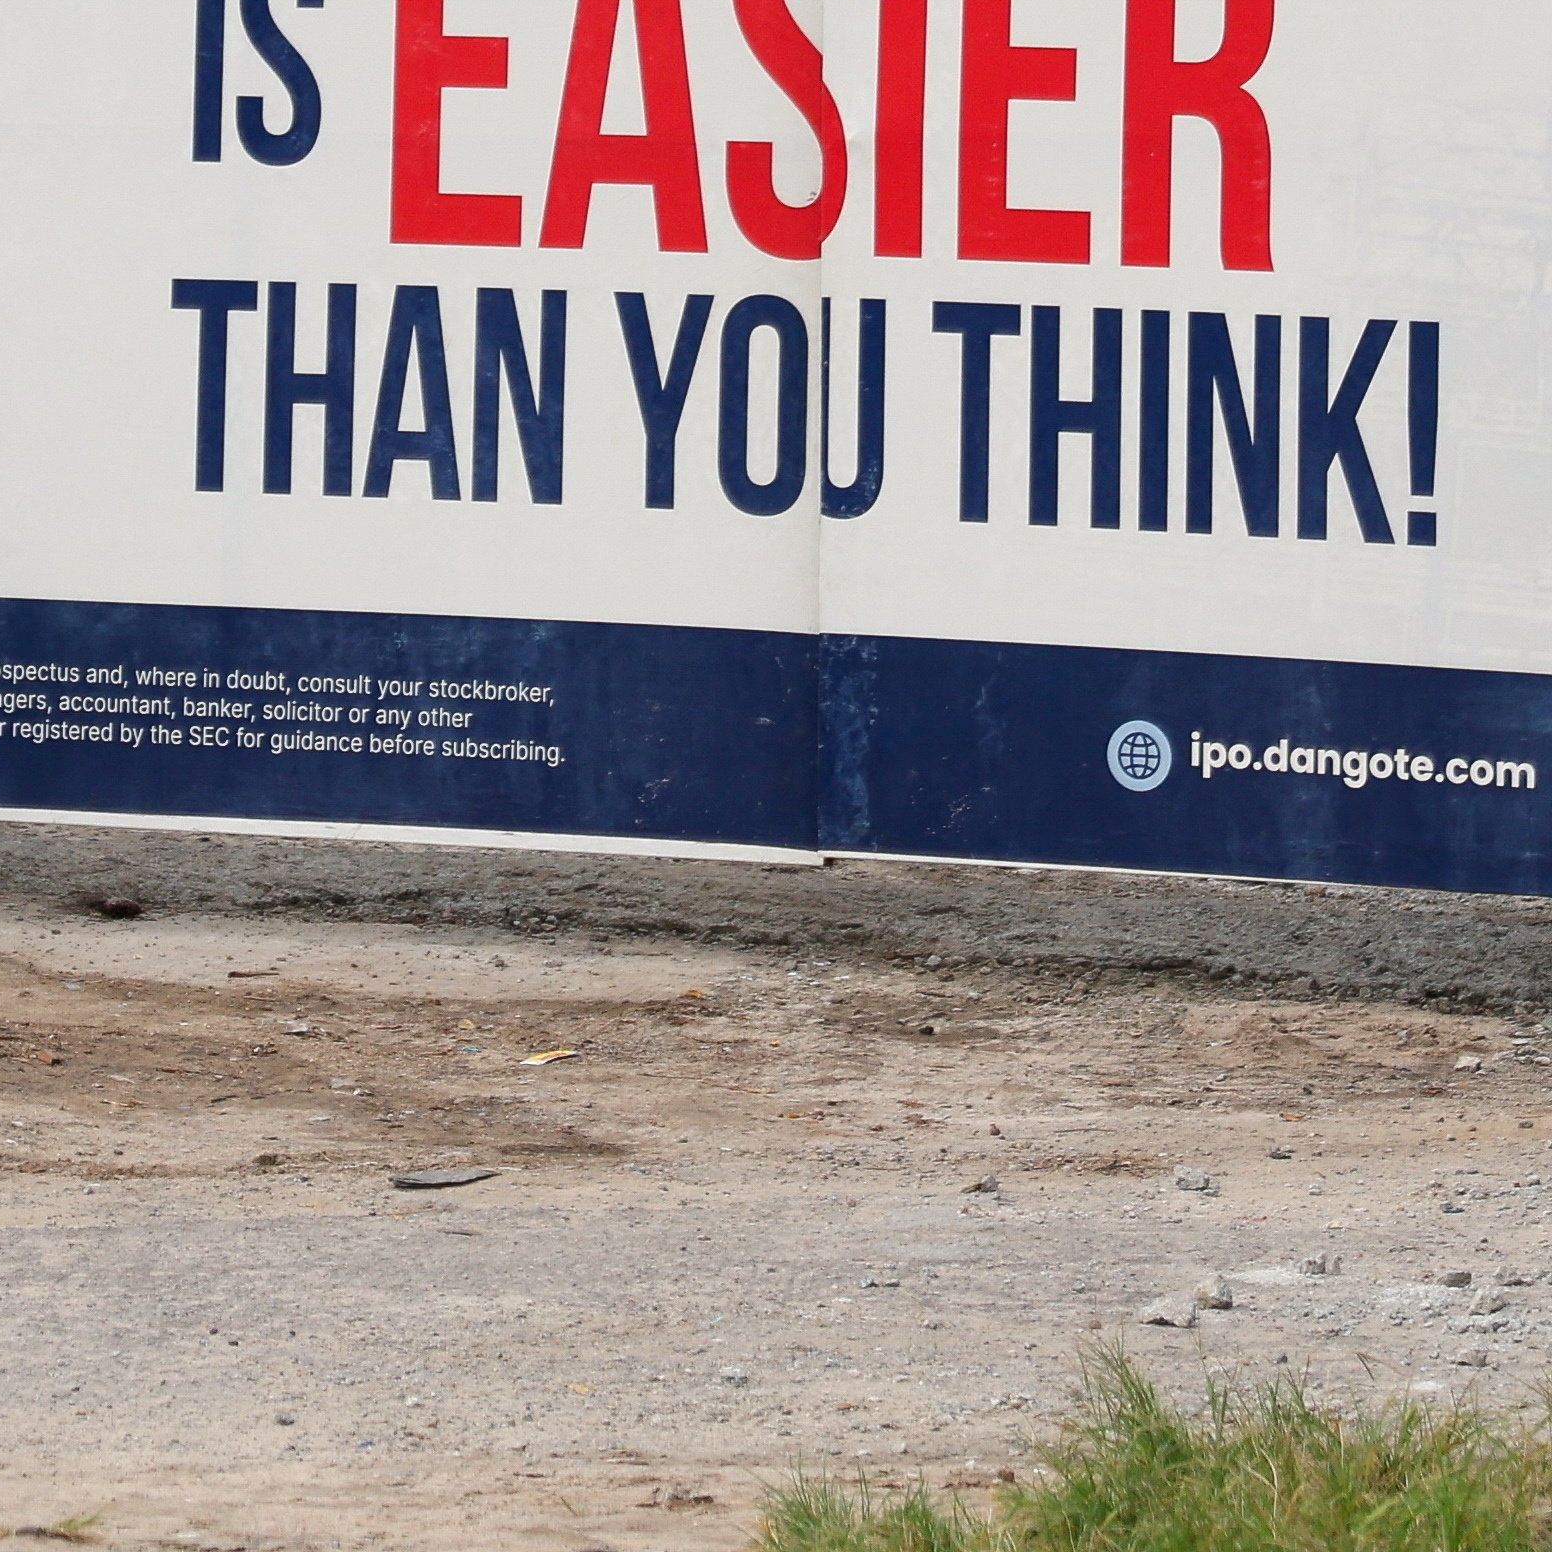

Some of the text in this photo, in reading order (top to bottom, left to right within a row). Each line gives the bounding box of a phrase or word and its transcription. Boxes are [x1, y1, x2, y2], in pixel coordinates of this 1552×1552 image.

[171, 278, 1440, 547] THAN YOU THINK!
[85, 664, 129, 689] and,
[135, 666, 197, 688] where
[202, 667, 220, 689] in
[226, 669, 292, 696] doubt,
[297, 674, 372, 695] consult
[377, 679, 423, 700] your
[428, 679, 555, 708] stockbroker,
[58, 694, 176, 720] accountant,
[182, 696, 256, 723] banker,
[262, 700, 343, 723] solicitor
[348, 706, 369, 724] or
[375, 707, 412, 730] any
[417, 707, 473, 729] other
[12, 718, 113, 744] registered
[119, 722, 144, 749] by
[149, 724, 183, 746] the
[188, 725, 230, 748] SEC
[236, 726, 265, 749] for
[269, 730, 363, 756] guidance
[369, 732, 435, 756] before
[441, 737, 566, 768] subscribing.
[1190, 730, 1536, 789] ipo.dangote.com
